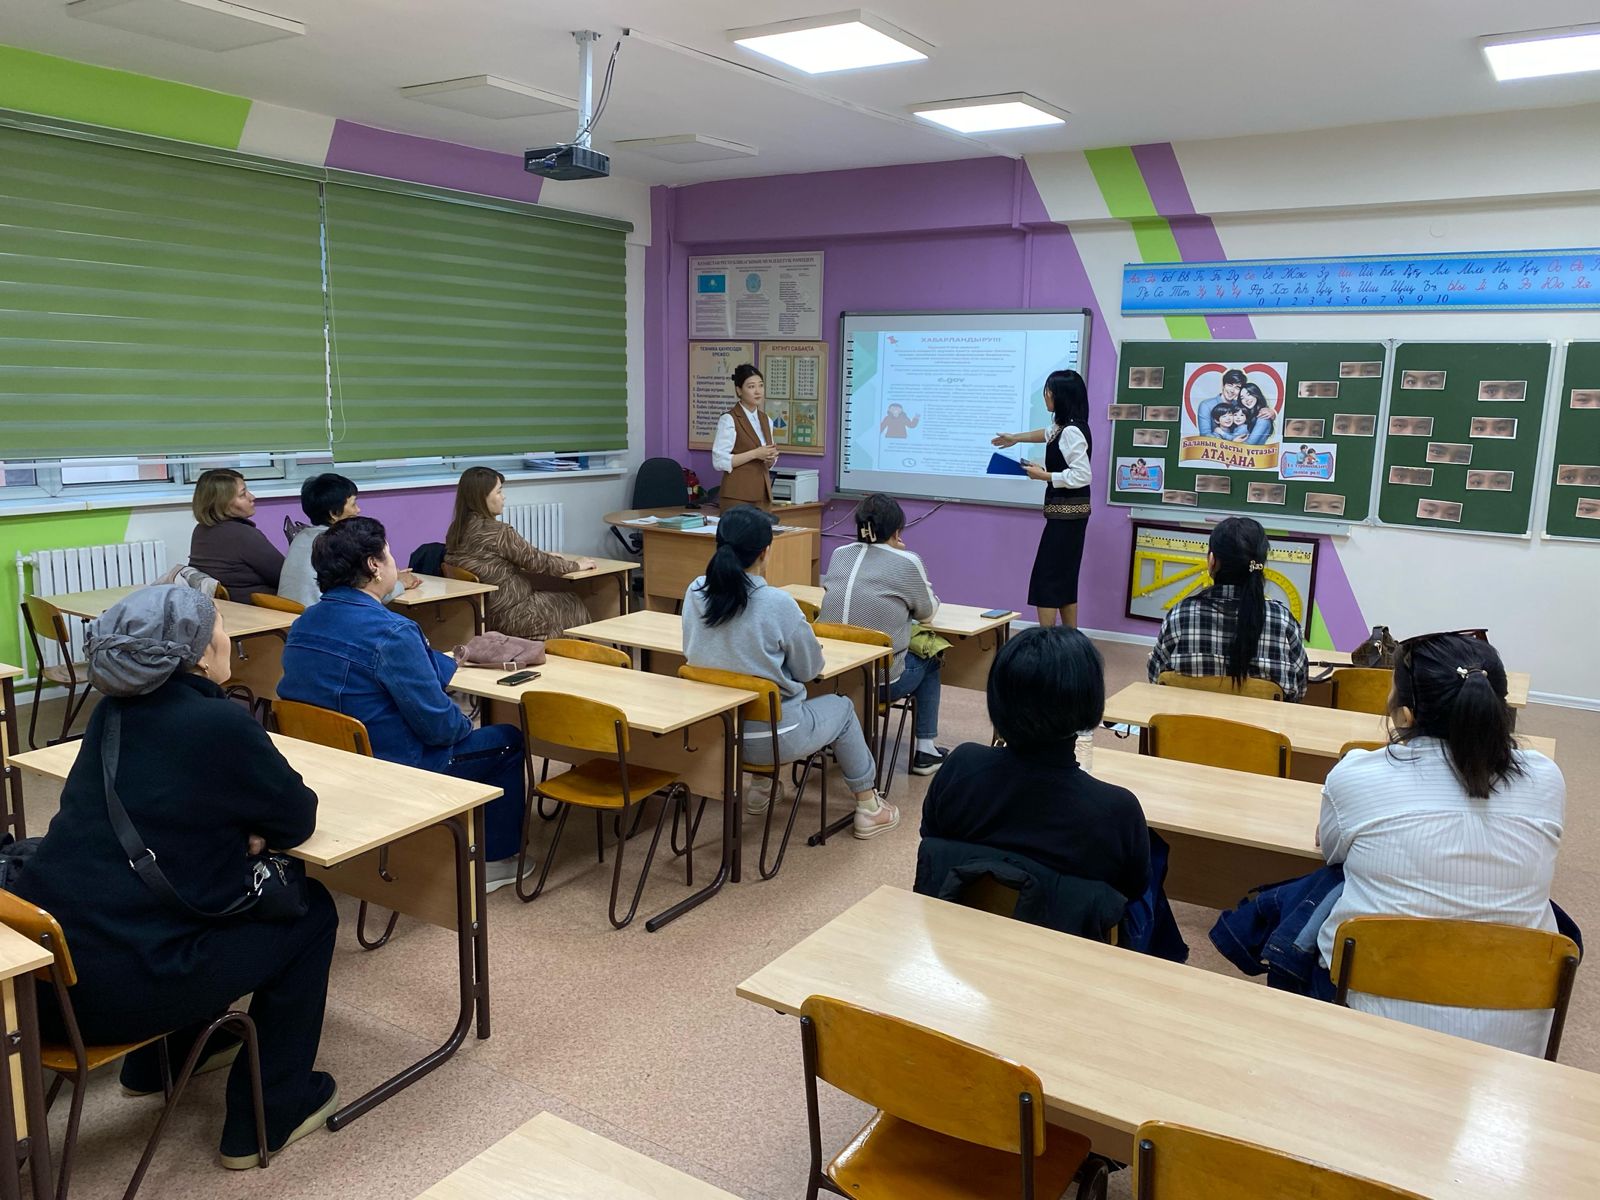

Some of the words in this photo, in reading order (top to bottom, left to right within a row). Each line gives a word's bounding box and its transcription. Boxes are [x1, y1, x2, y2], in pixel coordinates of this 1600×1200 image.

[1161, 270, 1177, 282] Бб
[1177, 271, 1191, 282] Вв
[1226, 269, 1239, 284] Дд
[1280, 267, 1308, 279] Жж
[1317, 266, 1330, 283] Зз
[1429, 263, 1450, 276] Лл
[1457, 262, 1485, 275] Мм
[1491, 260, 1512, 274] Нн
[1547, 259, 1561, 272] Оо
[1136, 286, 1149, 300] Рр
[1153, 286, 1164, 297] Сс
[1169, 285, 1191, 297] Тт
[1248, 283, 1264, 297] Фф
[1270, 283, 1289, 295] Хх
[1358, 281, 1378, 293] Шш
[1390, 280, 1416, 294] Щщ
[1541, 276, 1565, 289] Юю
[1259, 298, 1264, 306] 0
[1276, 297, 1280, 305] 1
[1291, 297, 1298, 305] 2
[1309, 297, 1315, 305] 3
[1326, 296, 1333, 305] 4
[1344, 296, 1350, 305] 5
[1362, 295, 1368, 304] 6
[1380, 295, 1386, 304] 7
[1398, 295, 1404, 304] 8
[1417, 294, 1423, 303] 9
[1436, 294, 1449, 303] 10
[1182, 440, 1217, 449] Баланың
[1219, 442, 1243, 453] басты
[1201, 448, 1256, 467] АТА-АНА
